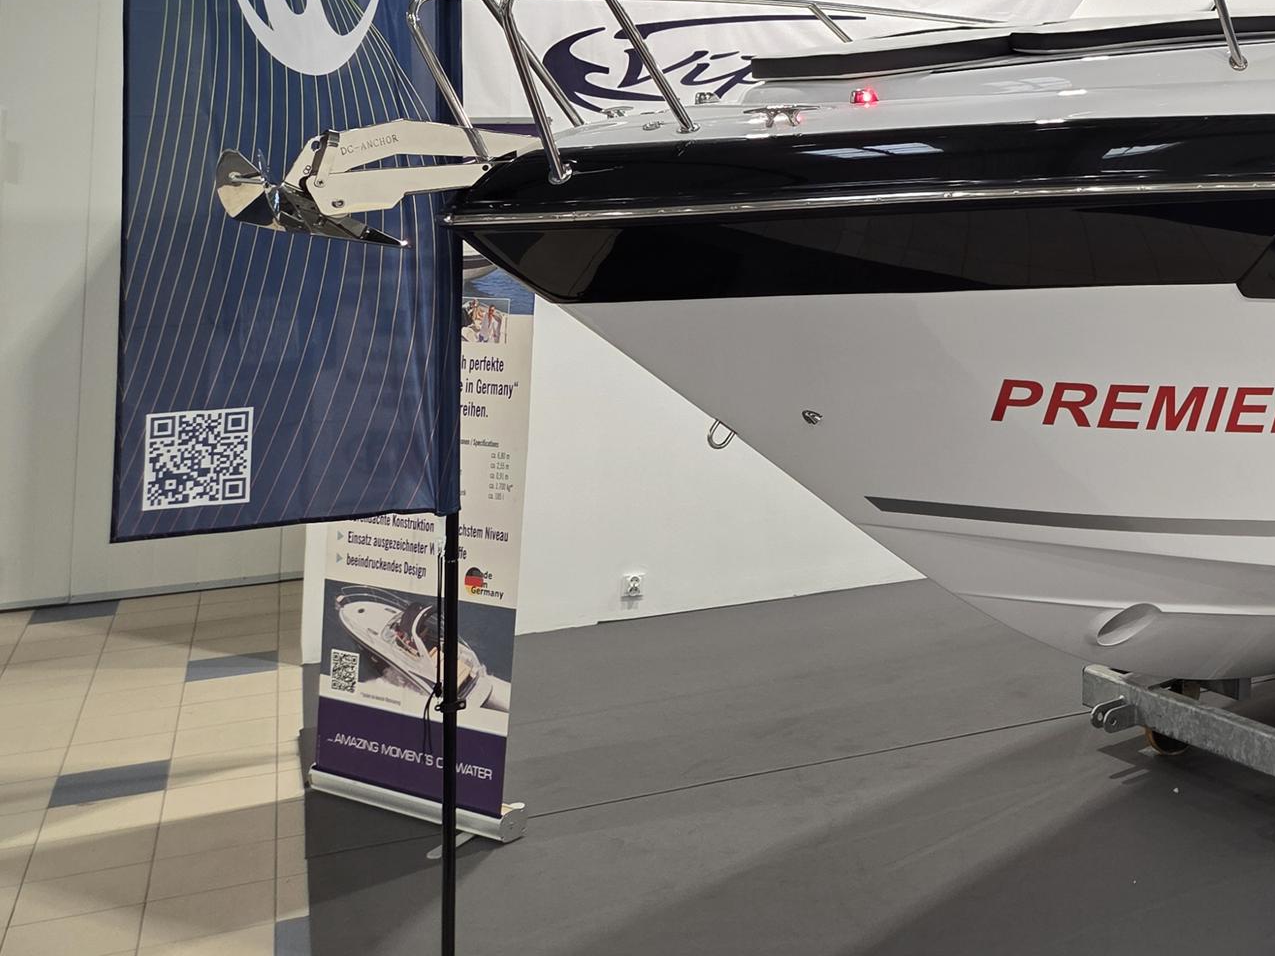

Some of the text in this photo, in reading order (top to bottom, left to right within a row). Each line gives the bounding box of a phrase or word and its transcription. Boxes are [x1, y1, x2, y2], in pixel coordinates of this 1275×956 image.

[340, 134, 399, 156] DC-ANCHOR
[469, 355, 505, 374] perfekte
[465, 377, 474, 394] in
[460, 401, 489, 418] reihen.
[392, 515, 435, 533] Konstruktion
[458, 524, 483, 540] chstem
[484, 526, 509, 542] Niveau
[348, 531, 372, 546] Einsatz
[373, 537, 429, 555] ausgezeichneter
[346, 555, 427, 579] beeindruckendes Design
[470, 586, 505, 600] Germany
[455, 762, 493, 780] WATER
